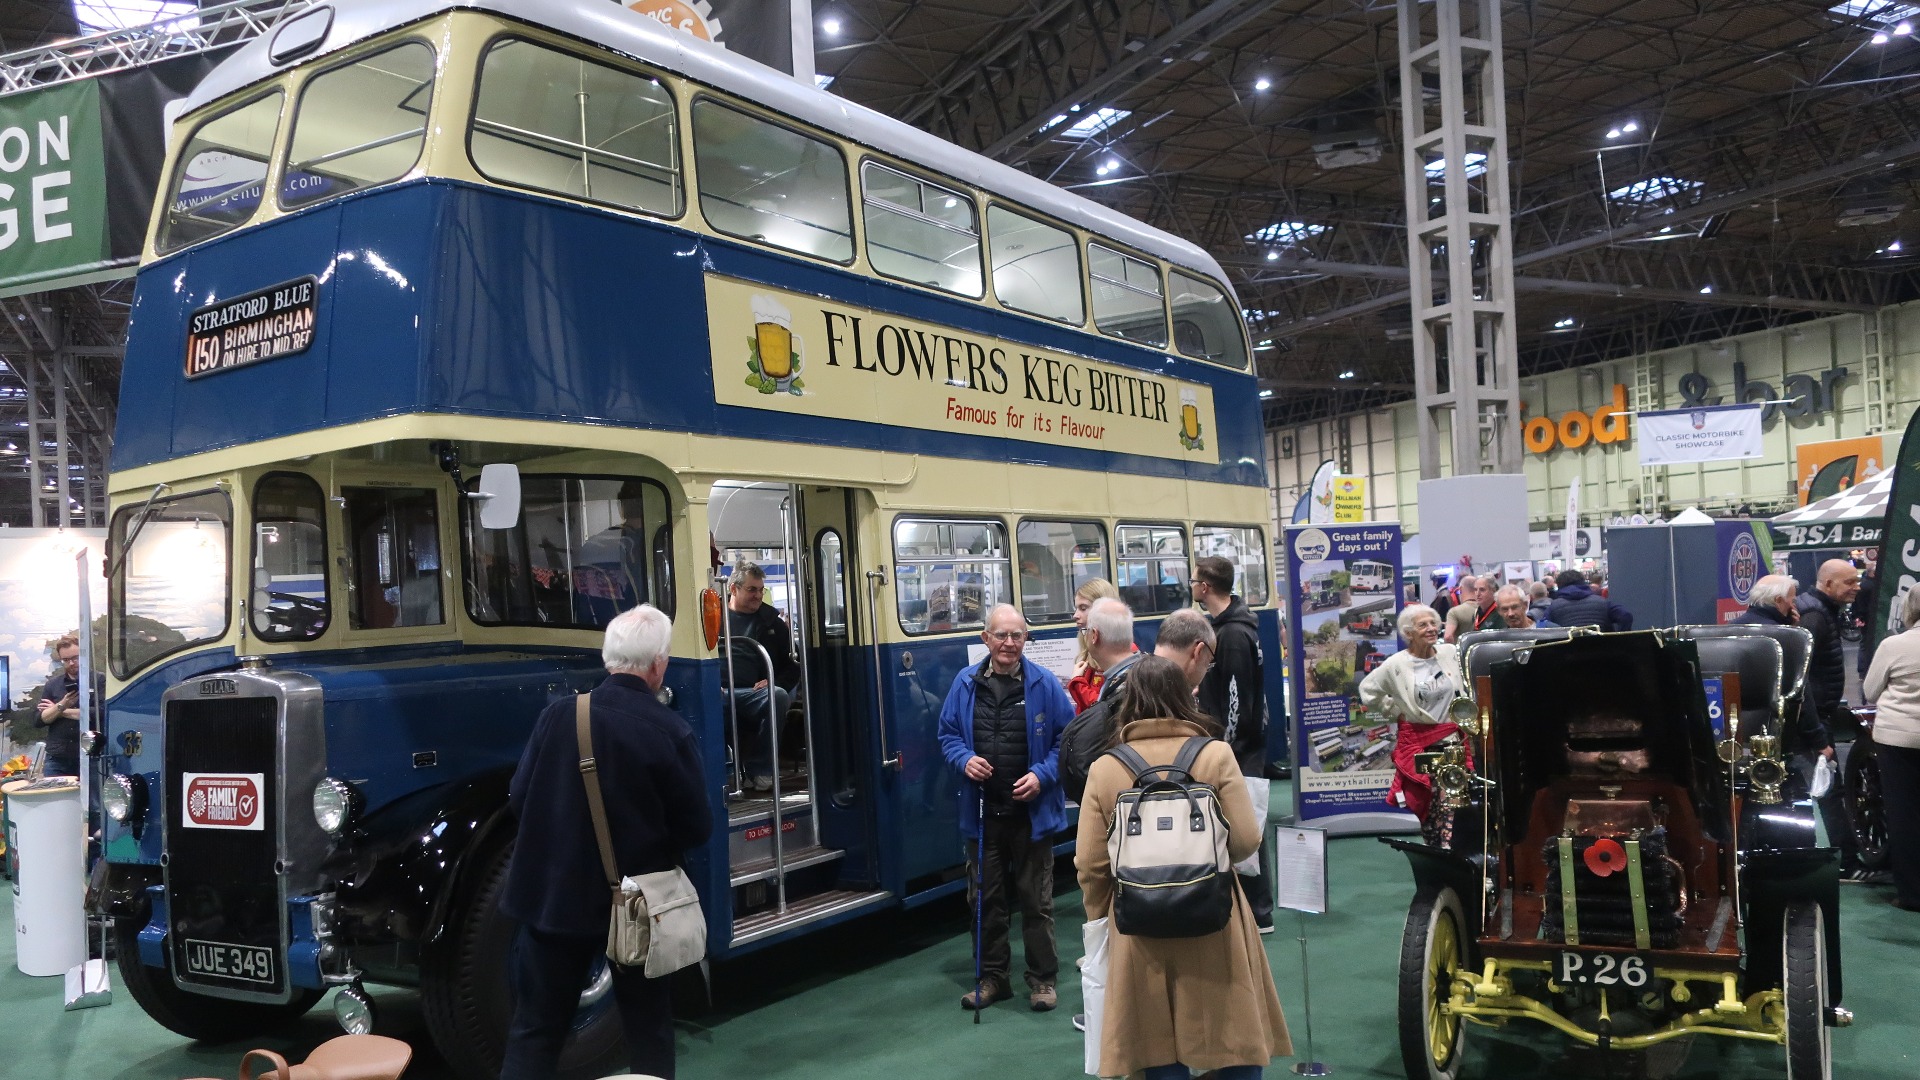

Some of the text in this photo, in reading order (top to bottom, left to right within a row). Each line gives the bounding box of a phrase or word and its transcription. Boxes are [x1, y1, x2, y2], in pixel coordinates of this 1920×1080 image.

[193, 282, 311, 333] STRATFORD BLUE
[195, 335, 220, 372] 150
[223, 351, 235, 367] ON
[237, 343, 259, 364] HIRE
[260, 341, 271, 358] TO
[273, 336, 290, 355] MID
[820, 309, 1169, 423] FLOWERS KEG BITTER
[946, 397, 1105, 441] Famous for its Flavour
[1520, 383, 1626, 453] ood
[1733, 361, 1848, 422] bar
[1655, 429, 1745, 442] CLASSIC MOTORBIKE
[1675, 440, 1725, 449] SHOWCASE
[1332, 530, 1394, 543] Great family
[1789, 523, 1843, 546] BSA
[1338, 543, 1361, 554] days
[1364, 543, 1381, 551] out
[1736, 559, 1751, 579] GB
[207, 787, 238, 806] FAMILY
[207, 806, 238, 821] FRIENDLY
[191, 944, 269, 978] JUE 349
[1562, 951, 1648, 987] P.26
